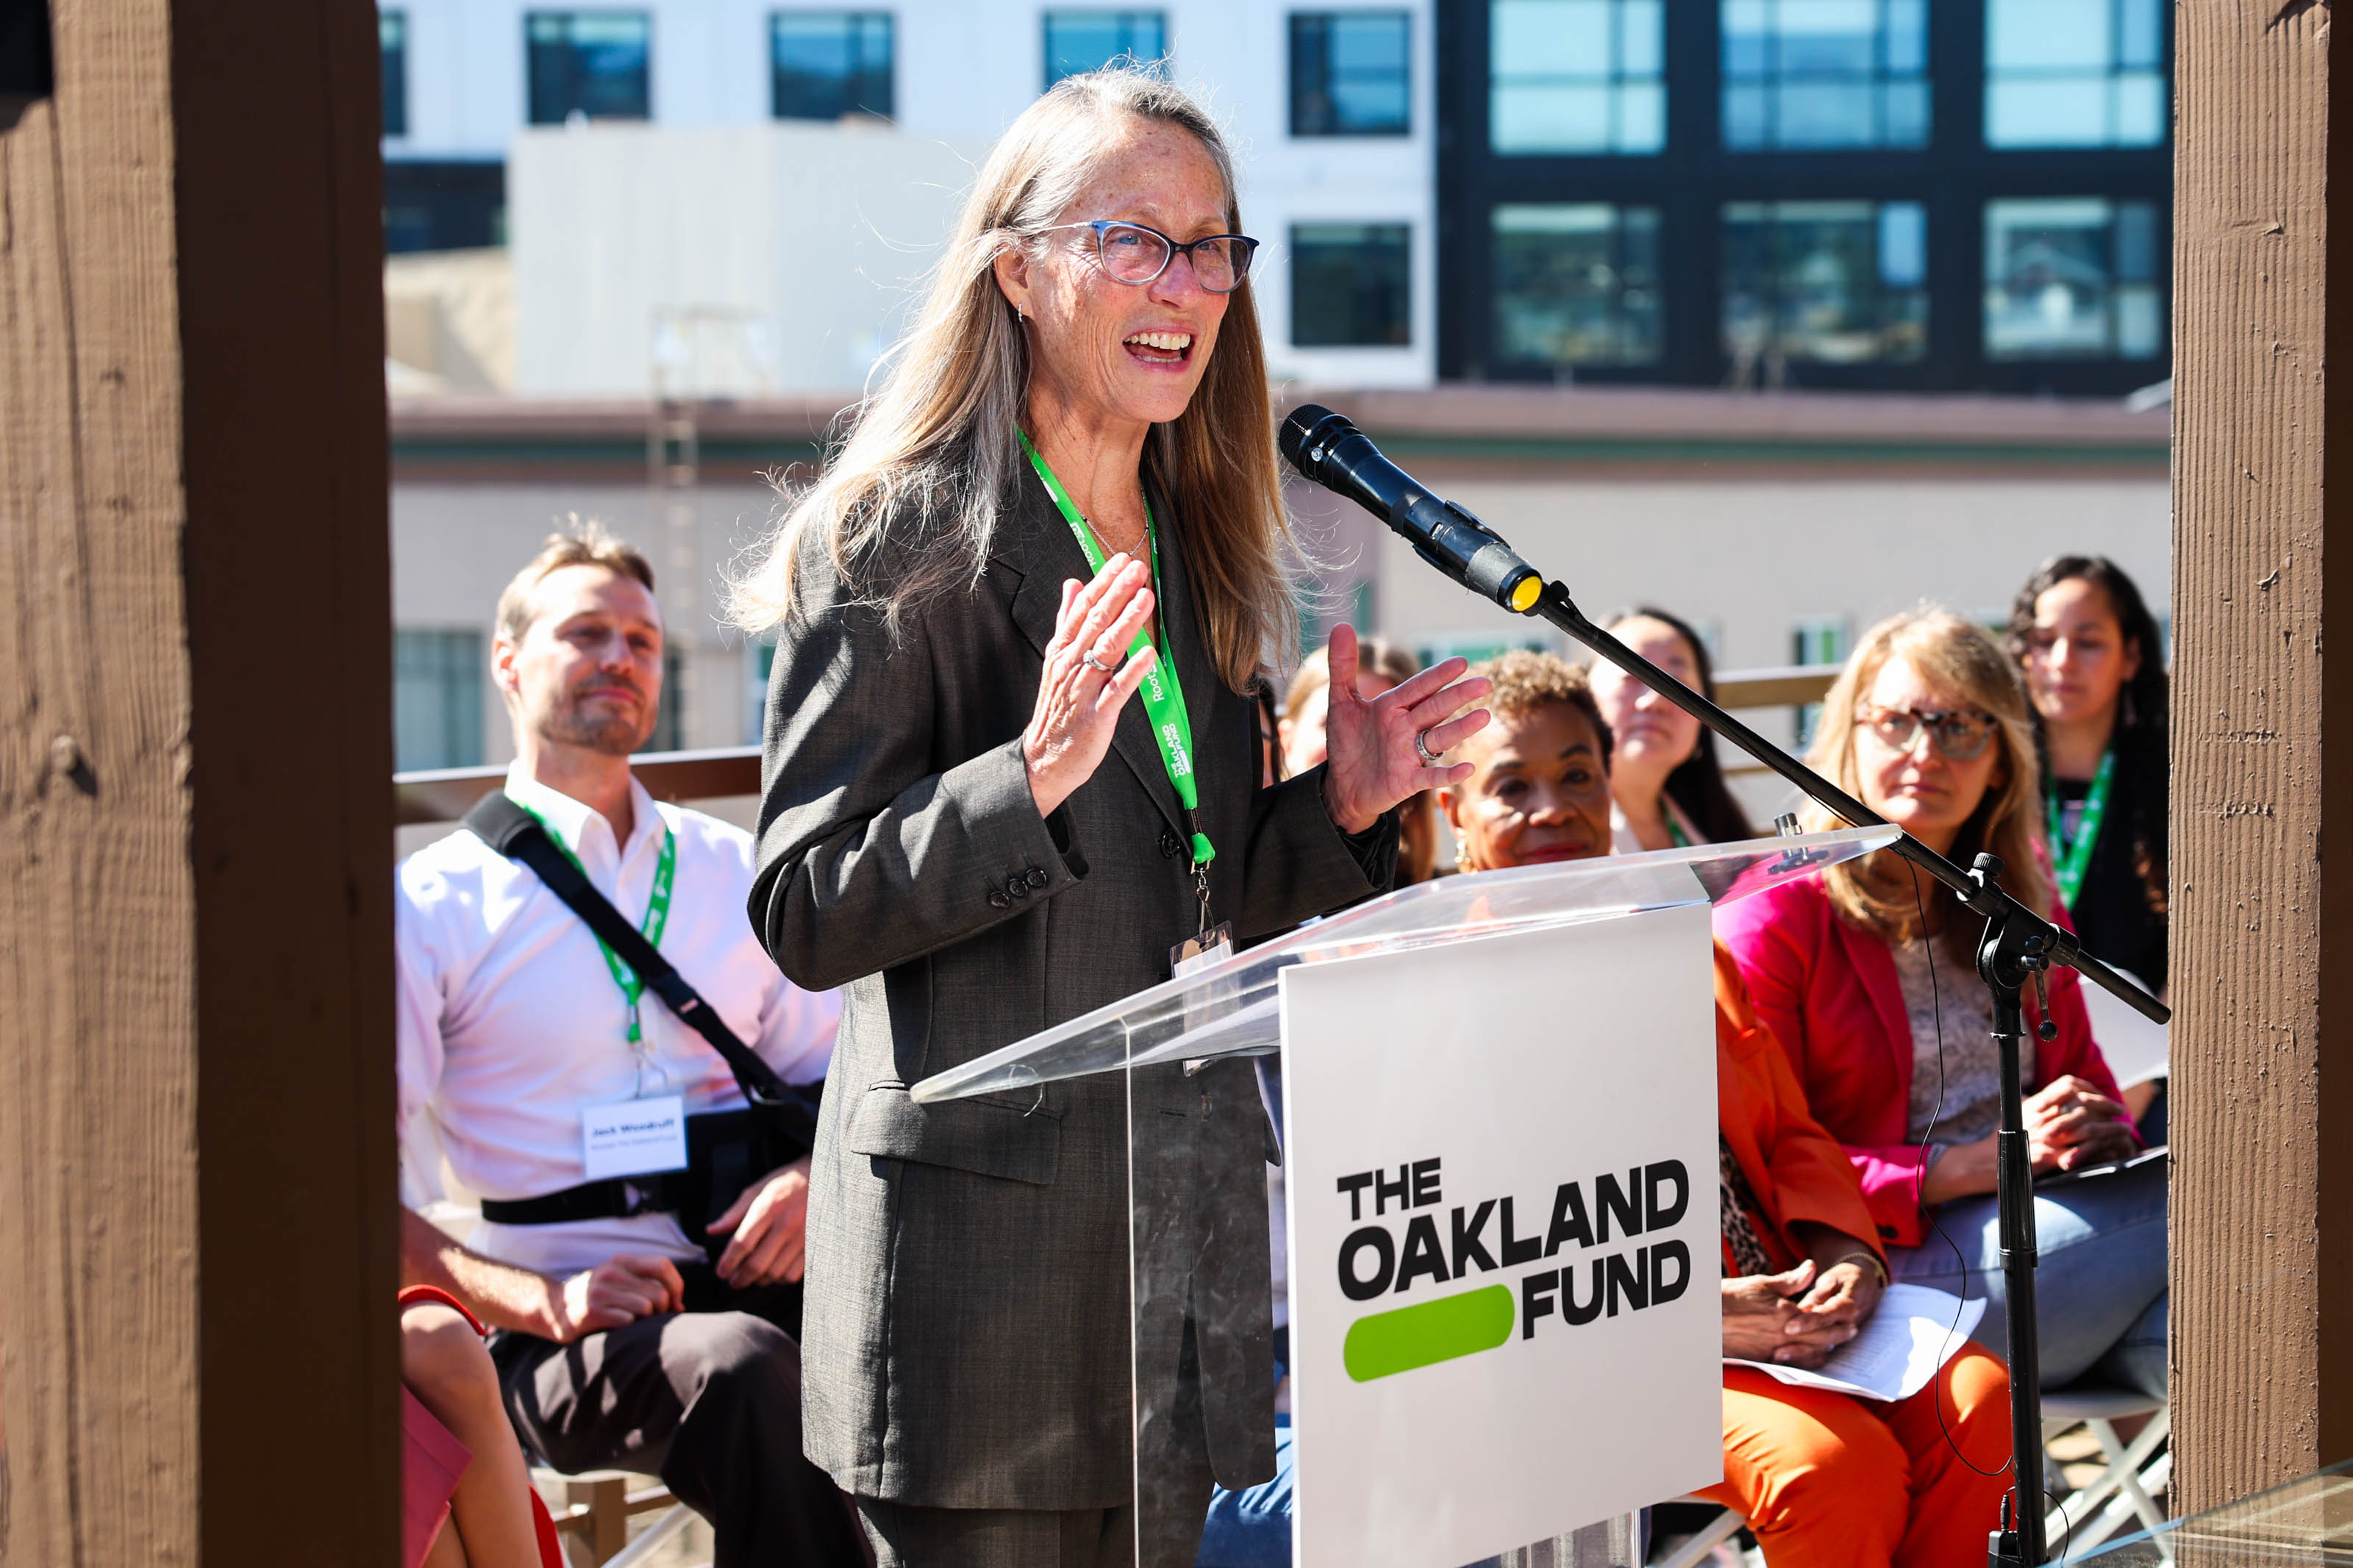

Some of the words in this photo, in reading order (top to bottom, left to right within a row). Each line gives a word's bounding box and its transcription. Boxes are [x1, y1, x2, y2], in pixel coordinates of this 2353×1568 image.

[1146, 666, 1165, 702] Root
[1162, 725, 1187, 776] OAKLAND
[1169, 723, 1184, 749] FUND
[1337, 1157, 1441, 1220] THE
[1338, 1159, 1689, 1300] OAKLAND
[1522, 1239, 1690, 1341] FUND
